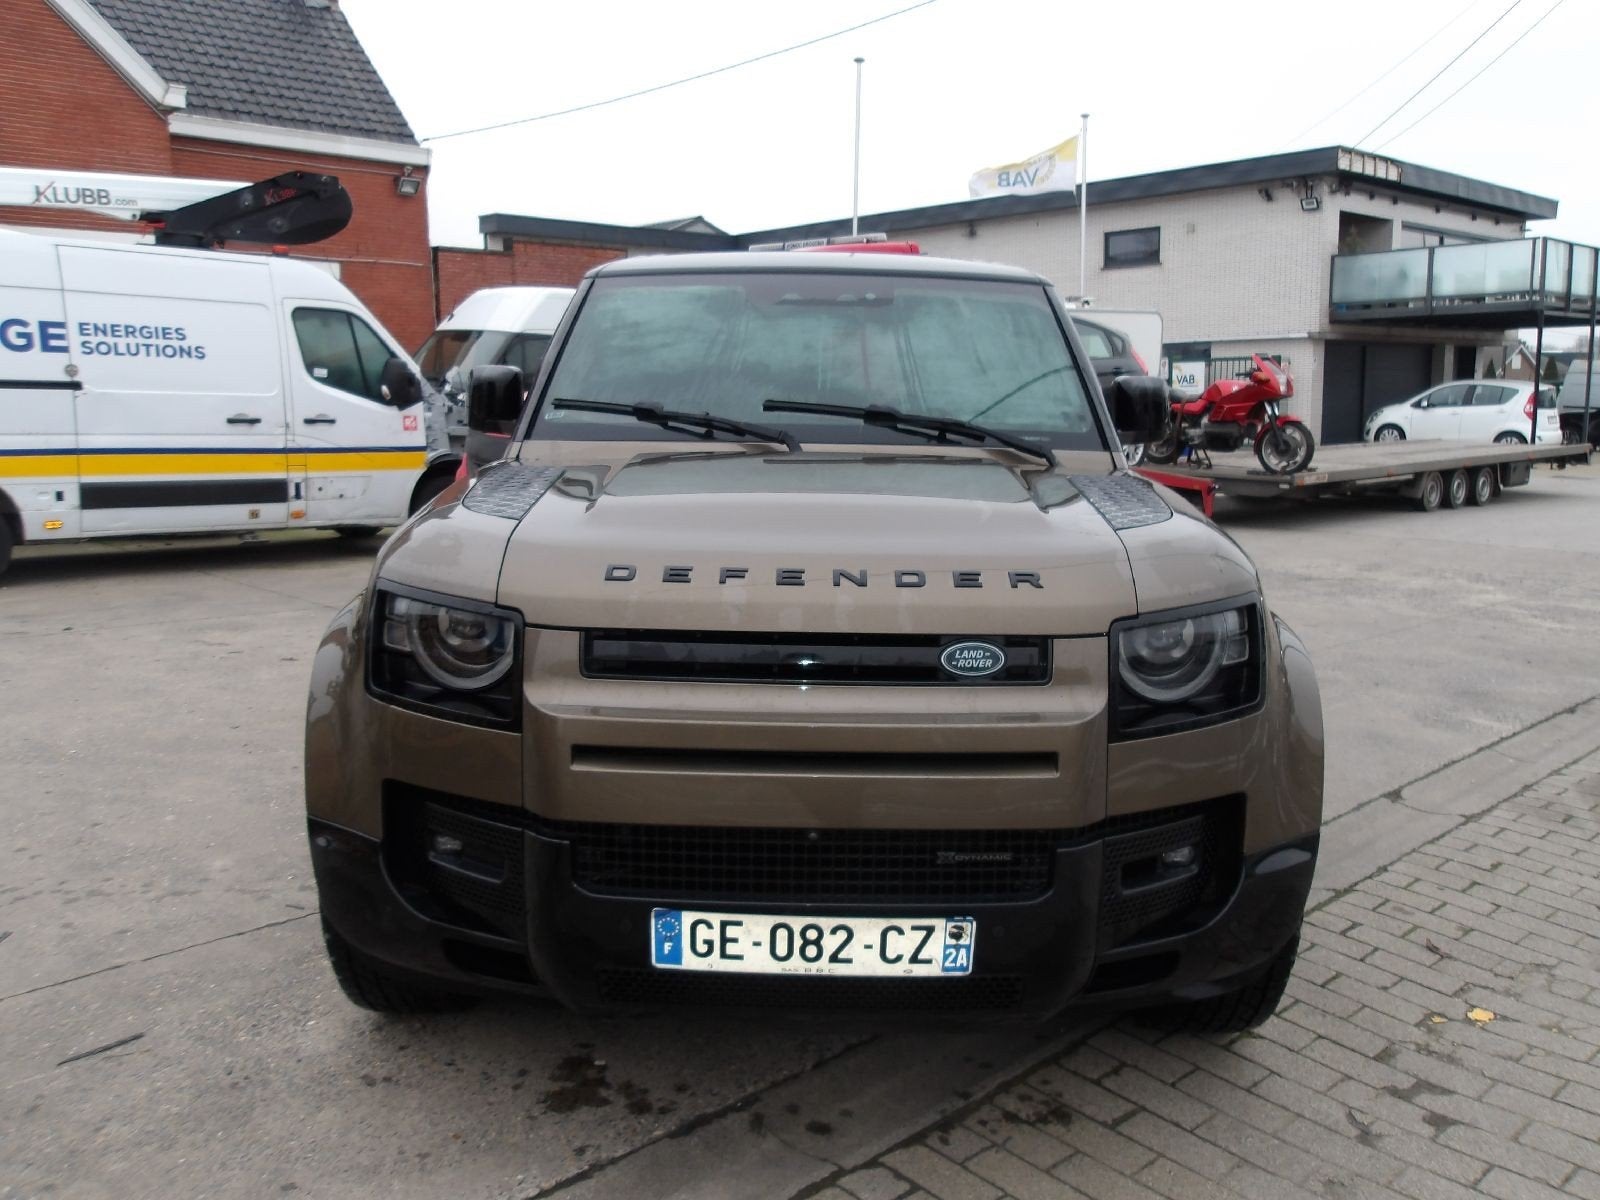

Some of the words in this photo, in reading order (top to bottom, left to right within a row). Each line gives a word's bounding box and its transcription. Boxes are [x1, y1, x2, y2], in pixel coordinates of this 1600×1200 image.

[0, 318, 69, 353] GE
[78, 322, 187, 341] ENERGIES
[80, 341, 206, 360] SOLUTIONS
[1176, 374, 1195, 385] VAB
[604, 564, 1044, 589] DEFENDER
[664, 942, 672, 954] F
[690, 918, 936, 964] GE-082-CZ
[944, 948, 967, 967] 2A
